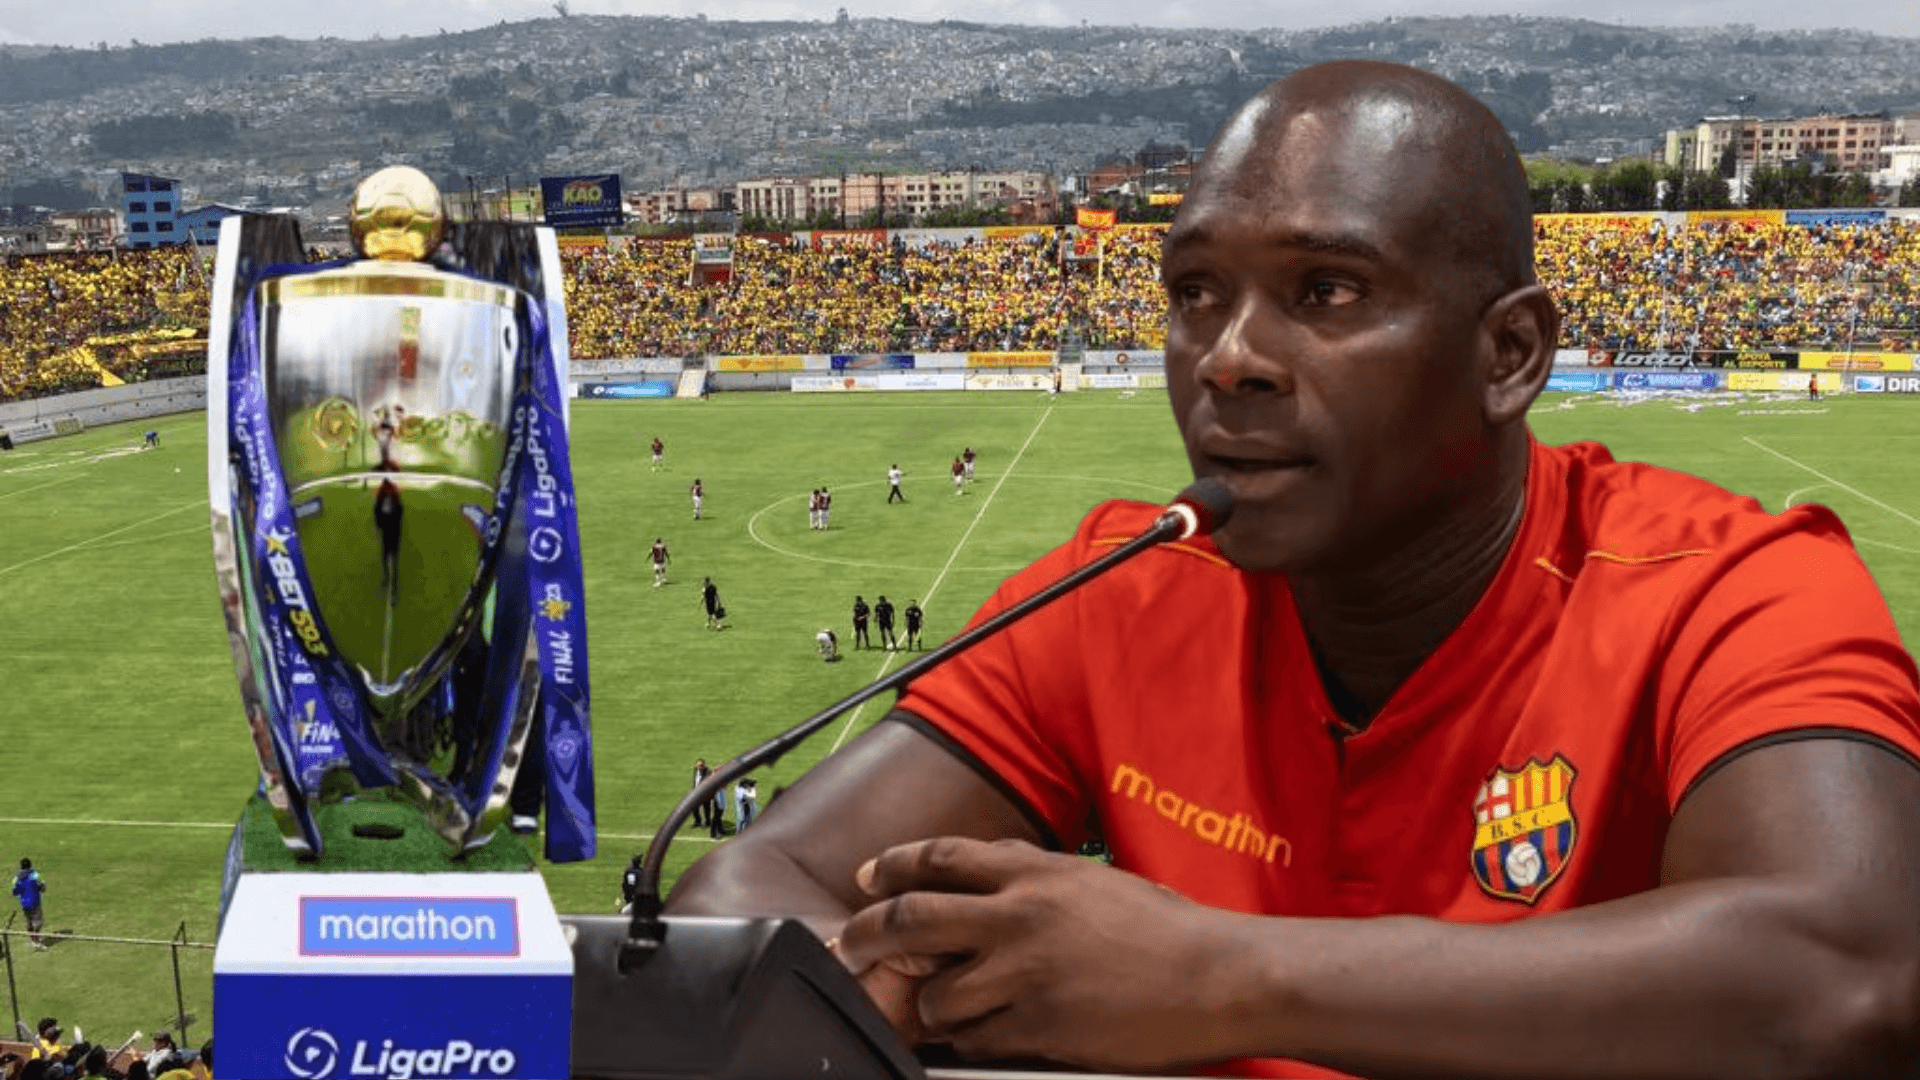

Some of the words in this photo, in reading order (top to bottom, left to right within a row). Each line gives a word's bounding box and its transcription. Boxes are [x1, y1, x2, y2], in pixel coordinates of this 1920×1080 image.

[526, 404, 558, 519] LigaPro
[547, 629, 574, 684] FINAL
[319, 907, 497, 941] marathon
[350, 1039, 516, 1080] LigaPro
